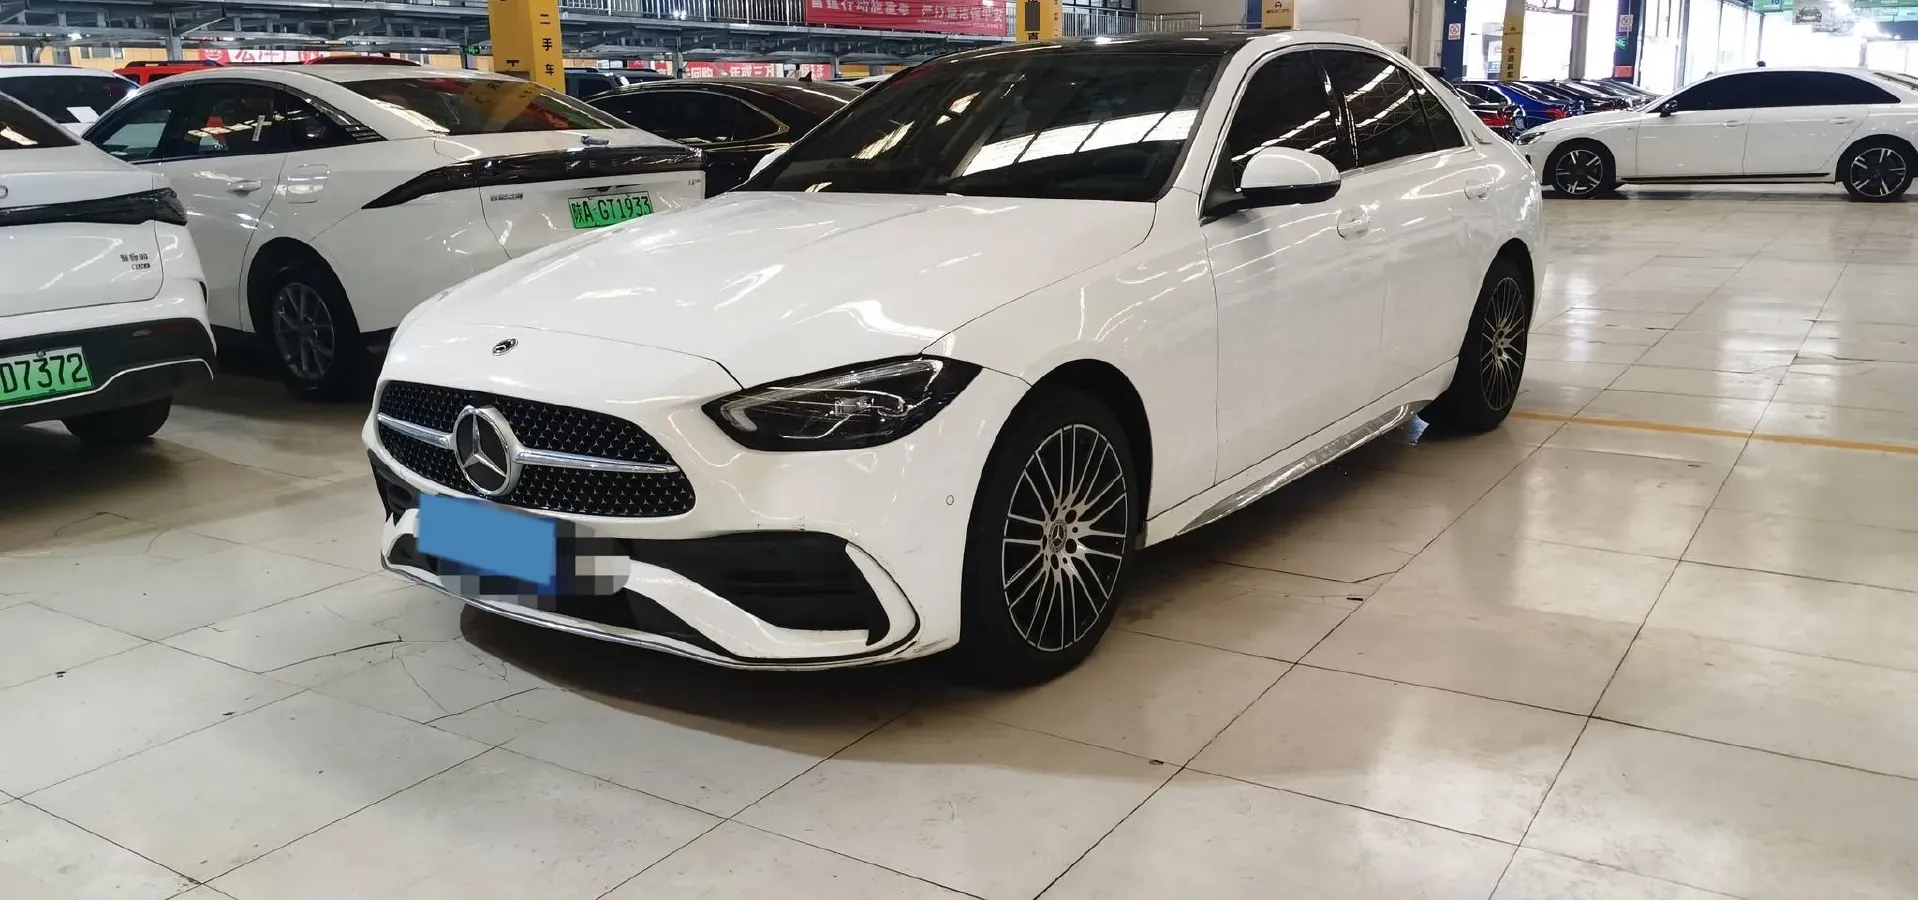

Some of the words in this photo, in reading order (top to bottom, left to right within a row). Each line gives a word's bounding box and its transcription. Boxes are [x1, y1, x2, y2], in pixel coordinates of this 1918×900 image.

[540, 13, 554, 76] 二手车
[0, 353, 88, 393] D7372
